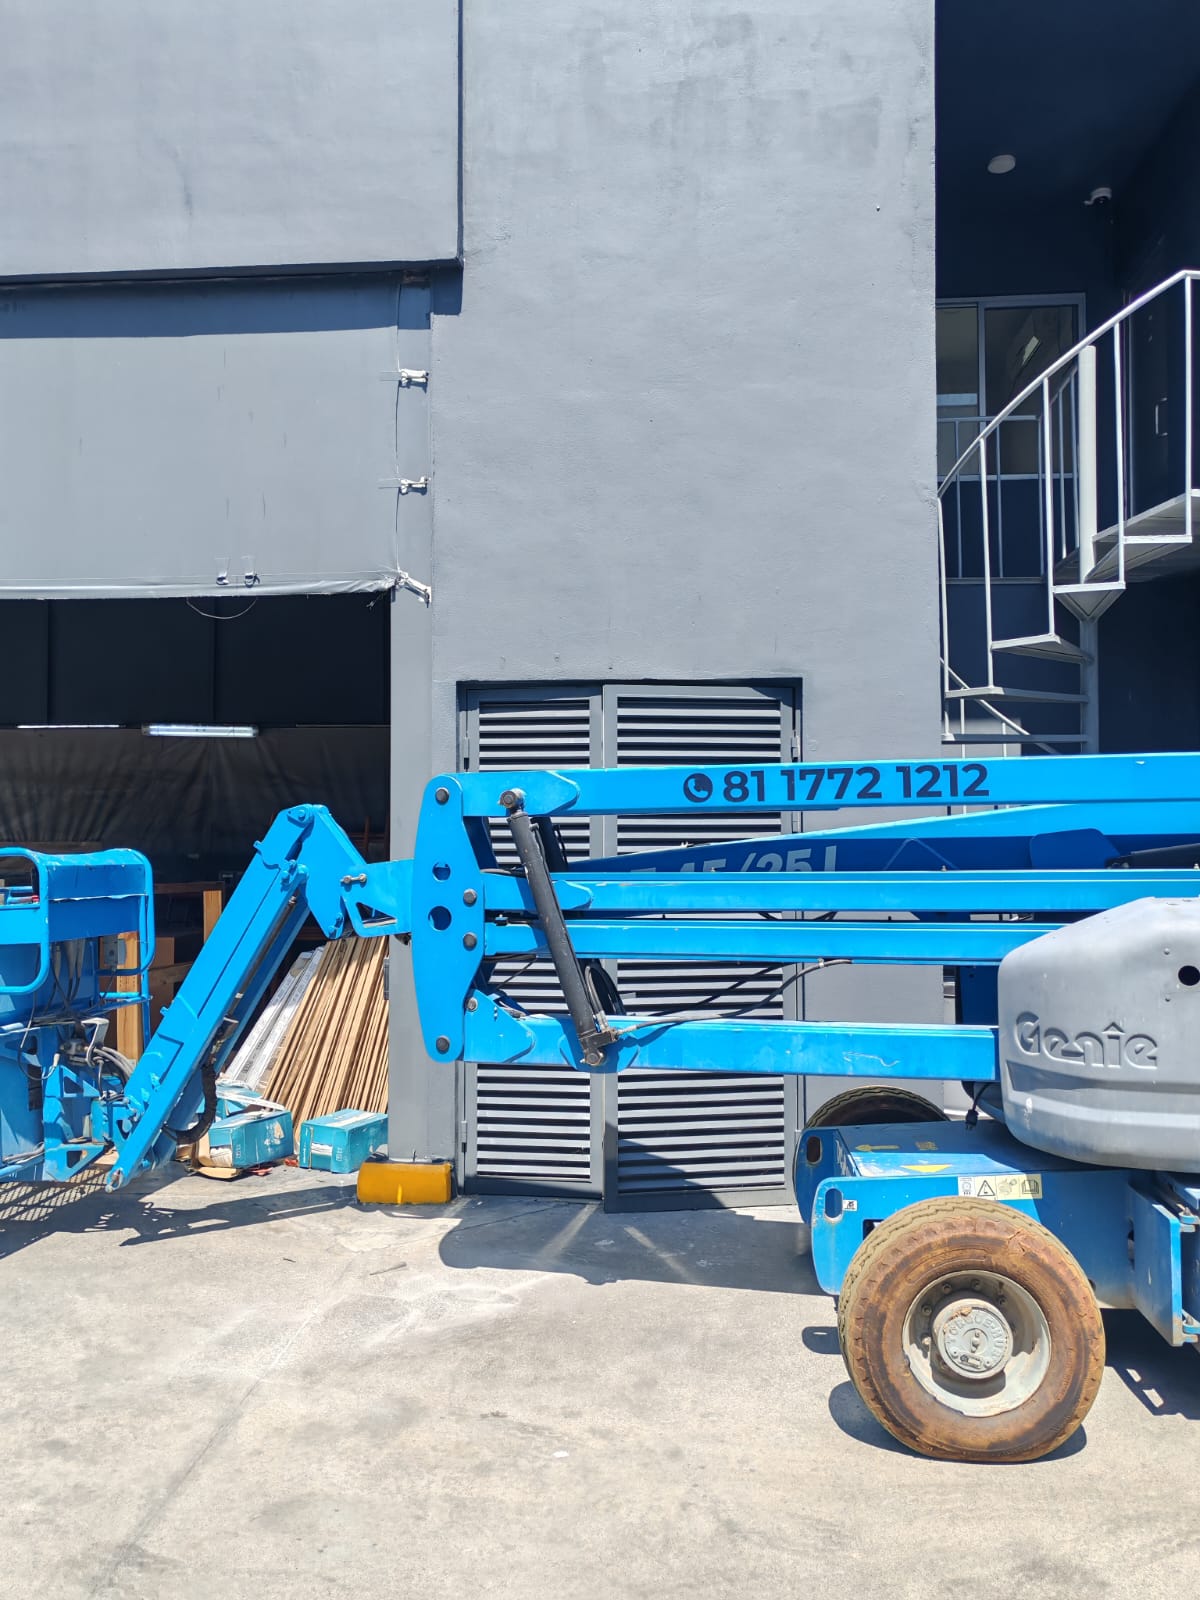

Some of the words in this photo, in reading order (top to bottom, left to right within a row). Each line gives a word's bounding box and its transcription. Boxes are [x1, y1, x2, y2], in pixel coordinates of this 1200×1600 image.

[723, 770, 766, 802] 81
[780, 766, 882, 801] 1772
[895, 763, 990, 798] 1212
[1014, 1011, 1158, 1070] Genie
